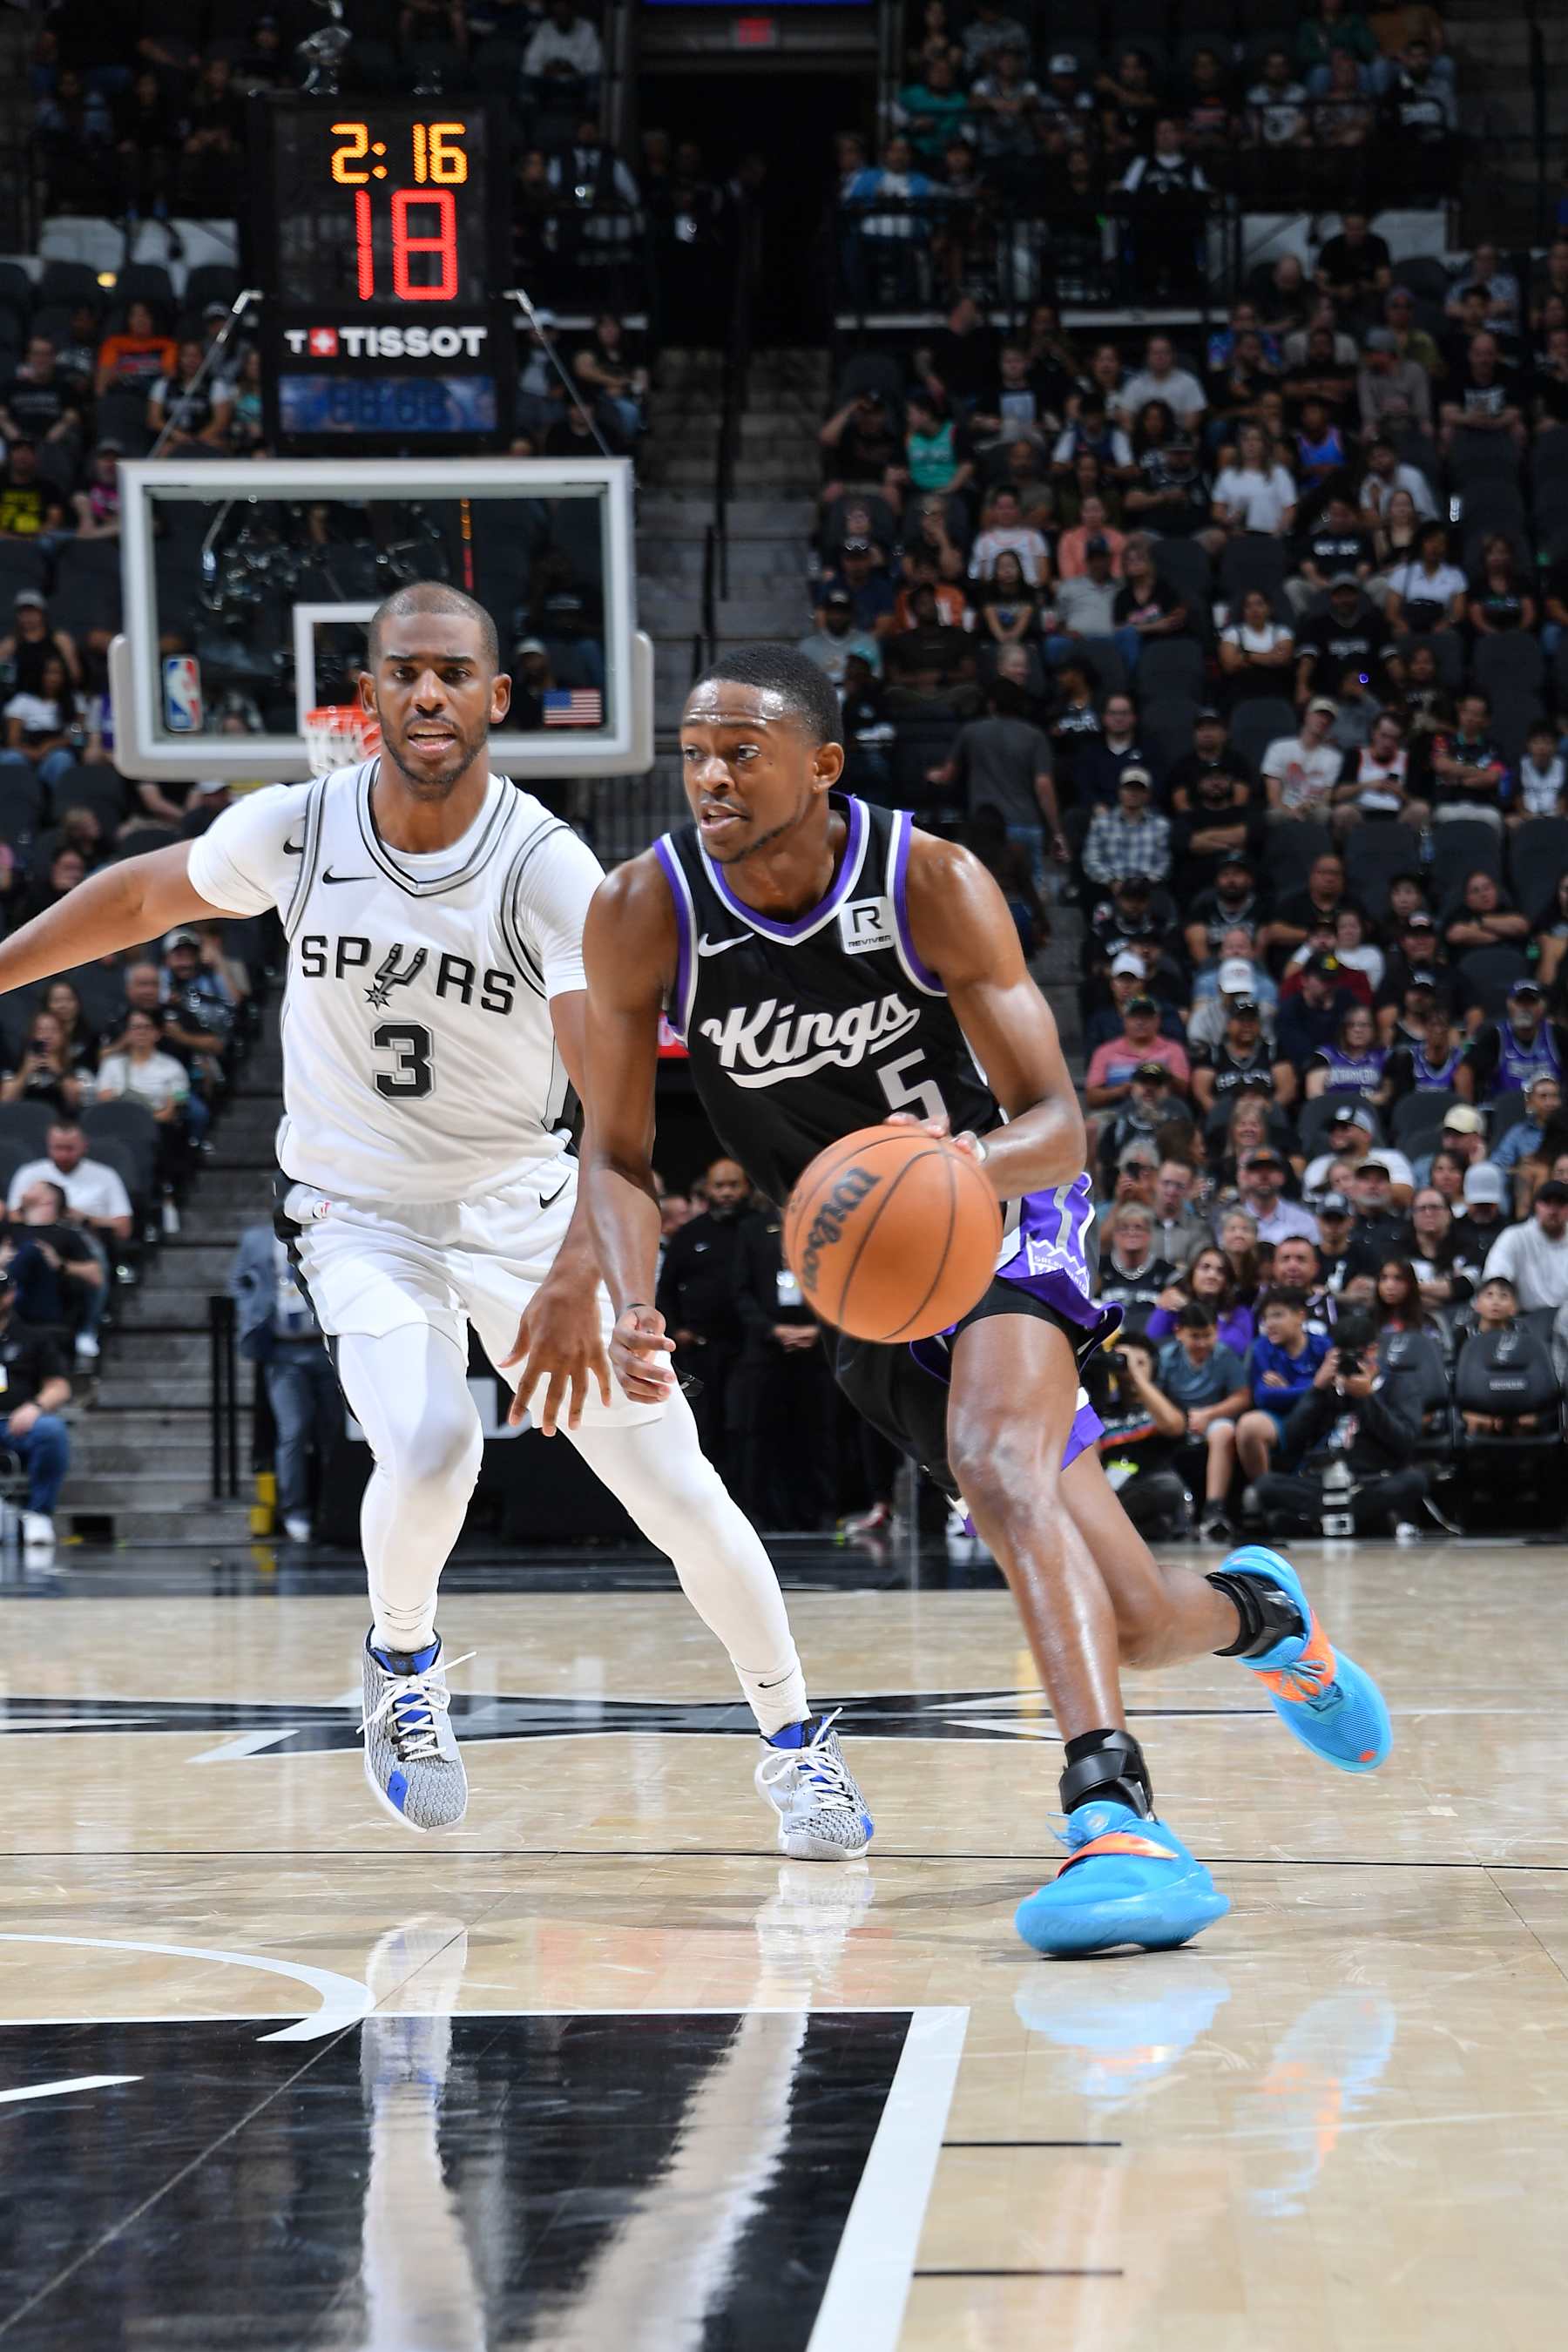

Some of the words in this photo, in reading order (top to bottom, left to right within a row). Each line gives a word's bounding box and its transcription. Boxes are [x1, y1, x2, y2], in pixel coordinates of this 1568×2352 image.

[331, 124, 469, 184] 2:16
[355, 189, 458, 301] 18
[338, 327, 488, 357] TISSOT
[848, 935, 892, 948] REVIVER
[853, 906, 883, 933] R
[301, 935, 517, 1016] SPURS
[371, 1021, 435, 1100] 3
[700, 993, 921, 1089] Kings
[876, 1048, 949, 1127] 5
[802, 1167, 882, 1292] Wilson
